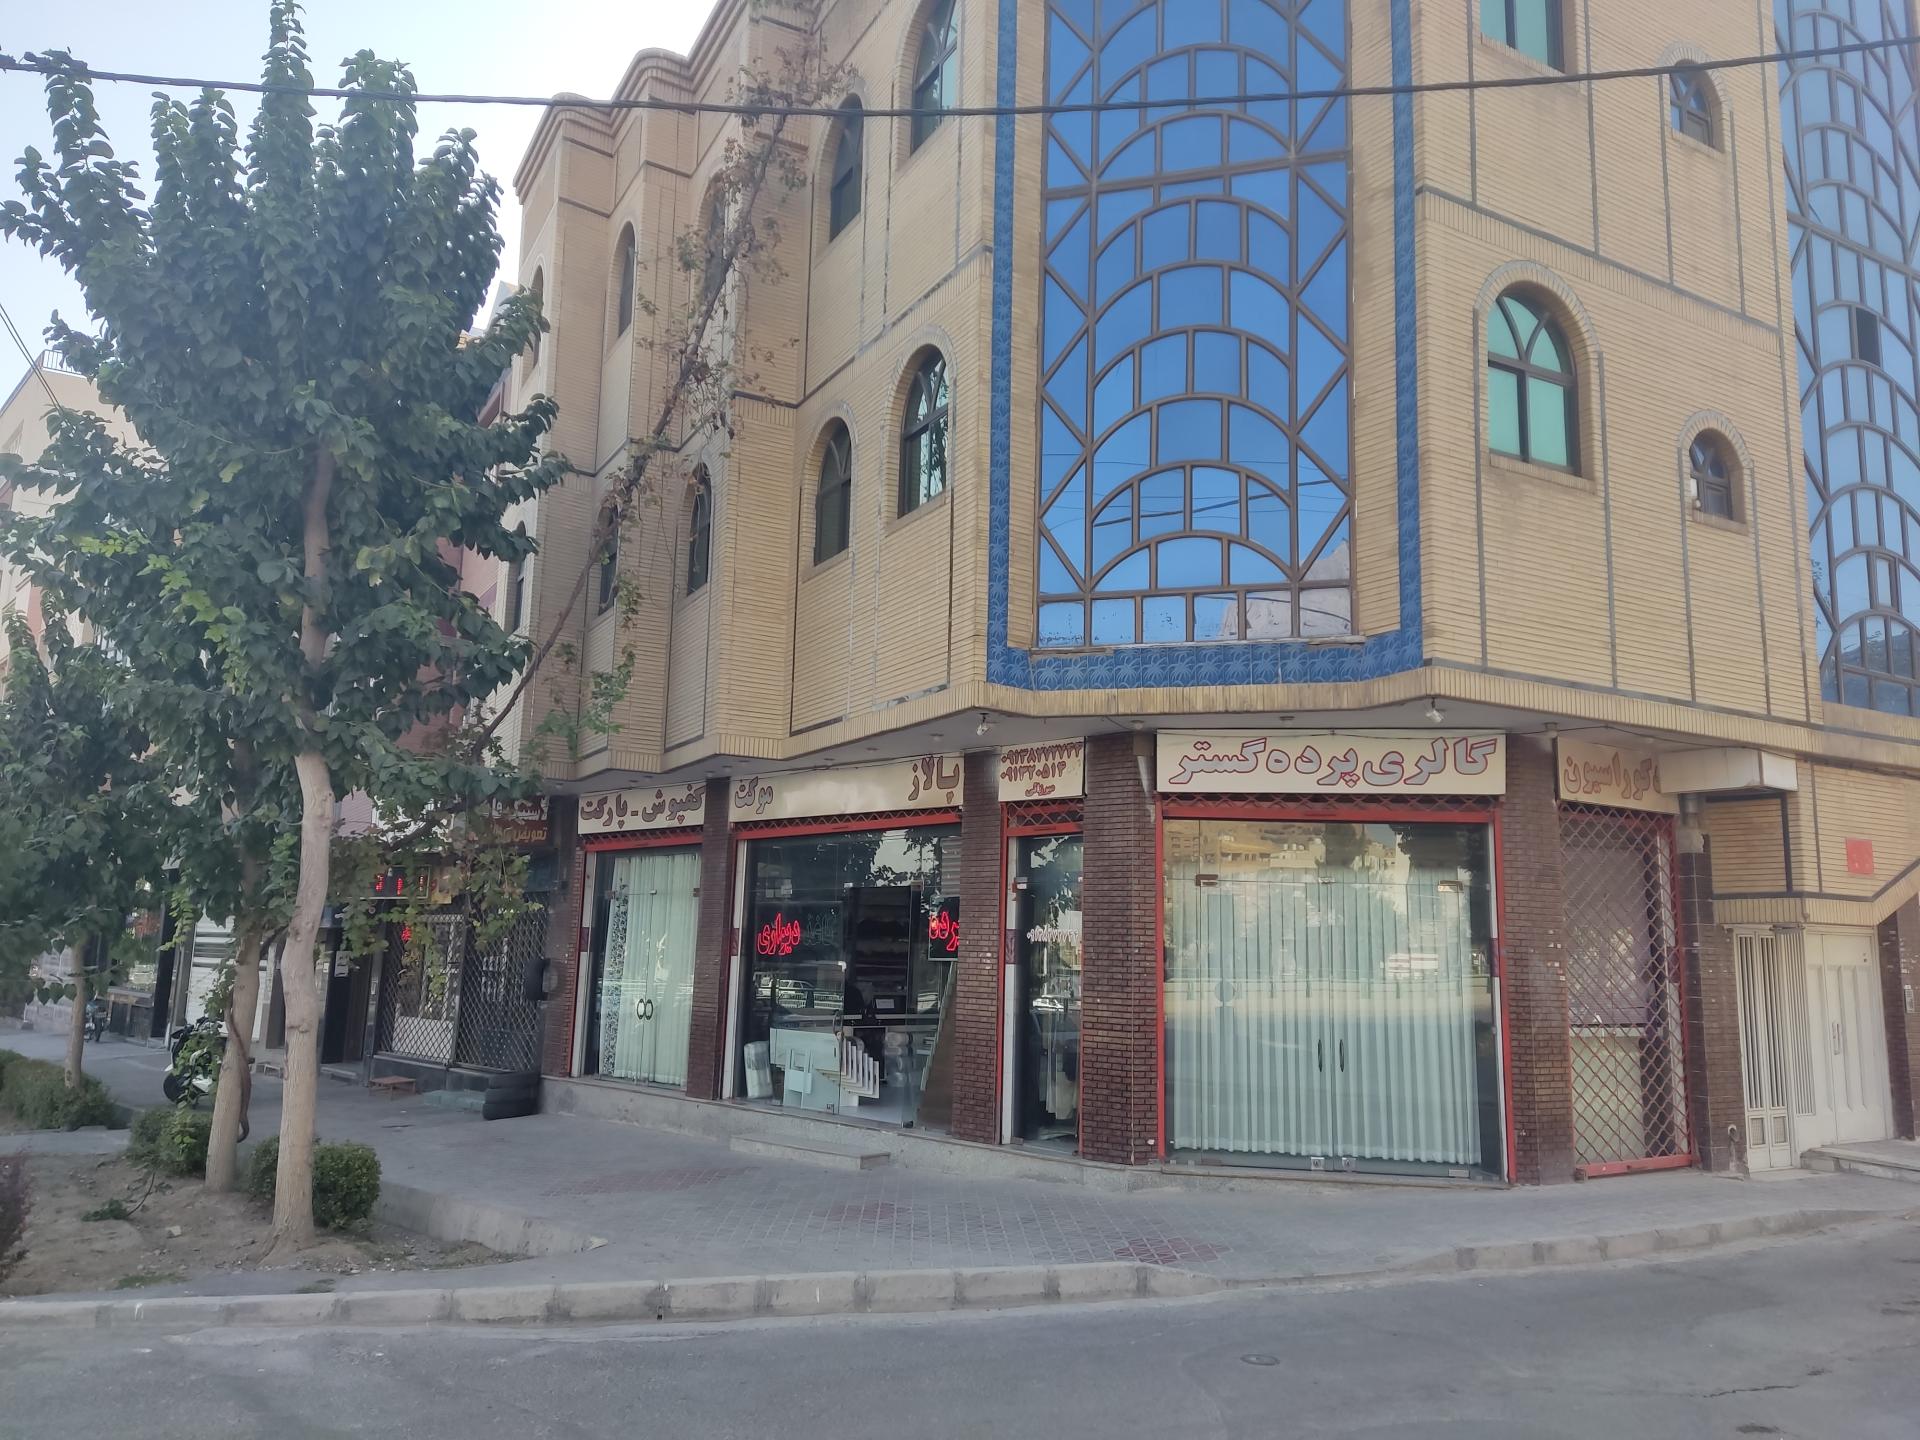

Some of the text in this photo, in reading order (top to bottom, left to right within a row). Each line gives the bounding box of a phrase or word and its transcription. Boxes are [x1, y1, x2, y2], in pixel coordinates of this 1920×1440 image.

[1168, 737, 1497, 787] گالری پرده گستر
[641, 784, 705, 824] کفپوش
[735, 755, 960, 814] پالاز موکت
[580, 793, 628, 829] پارکت
[758, 912, 801, 955] دیواری
